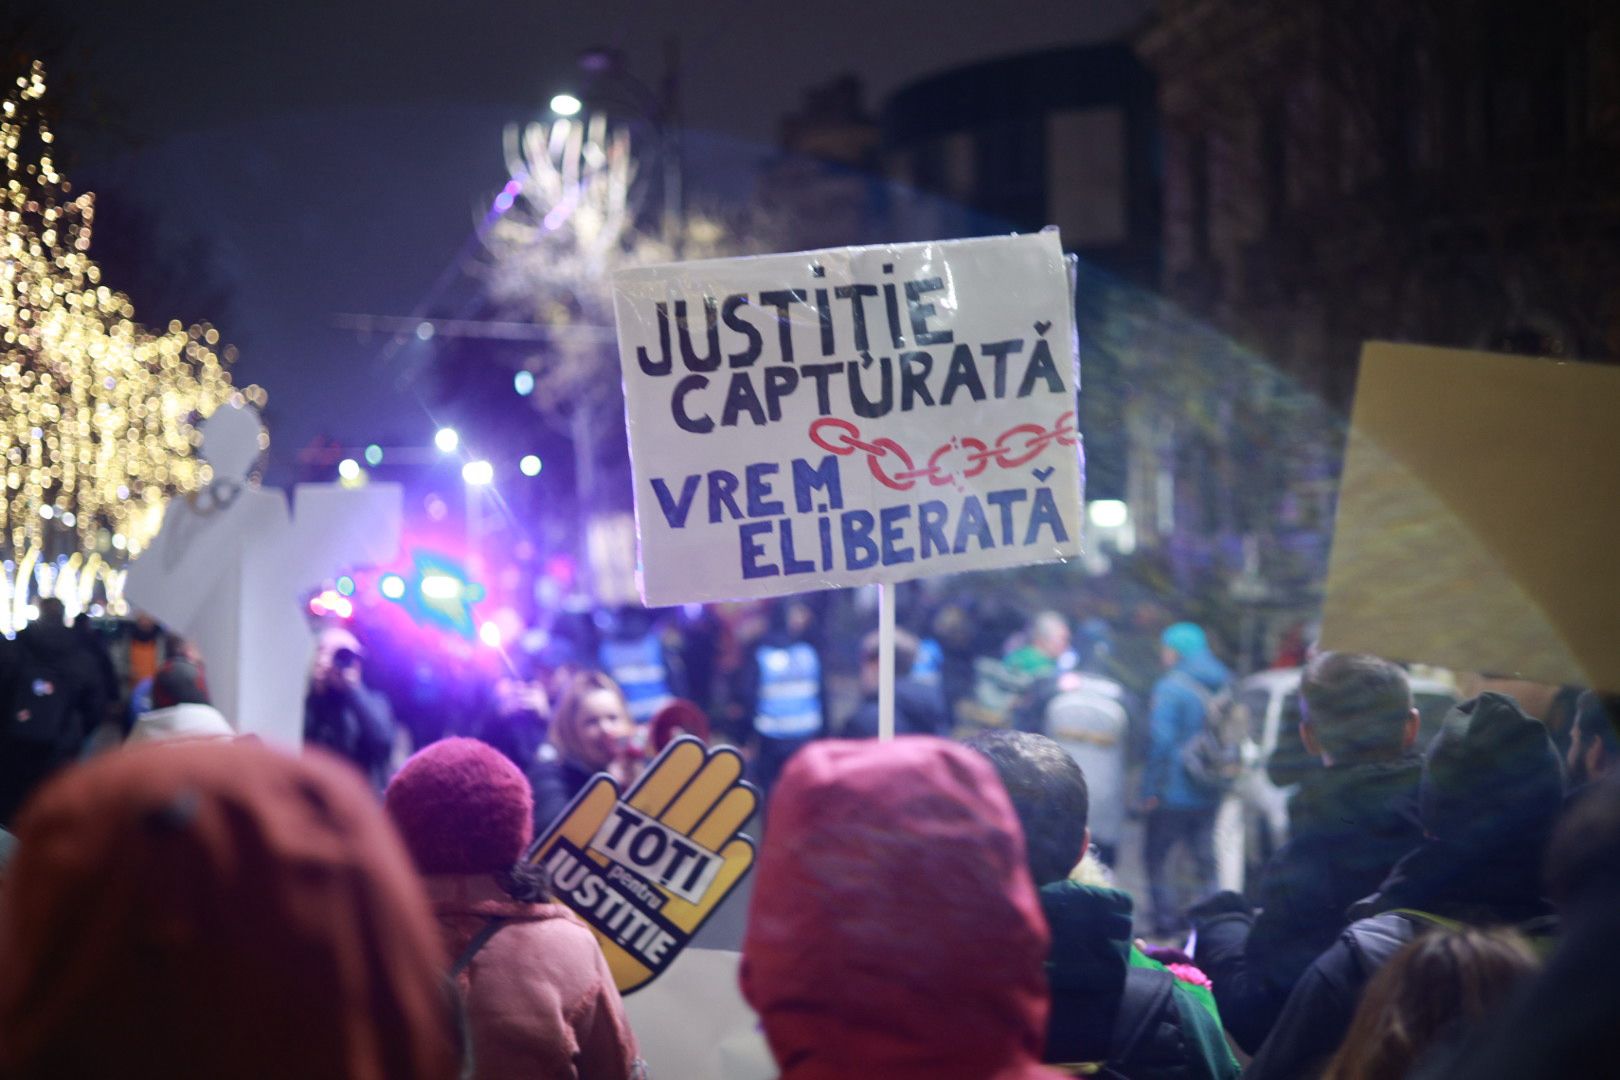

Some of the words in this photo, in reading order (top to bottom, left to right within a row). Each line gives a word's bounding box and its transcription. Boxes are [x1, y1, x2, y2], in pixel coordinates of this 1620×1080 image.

[670, 320, 1067, 433] CAPTURATĂ
[650, 455, 844, 529] VREM
[605, 806, 712, 893] TOȚI
[607, 864, 663, 910] pentru
